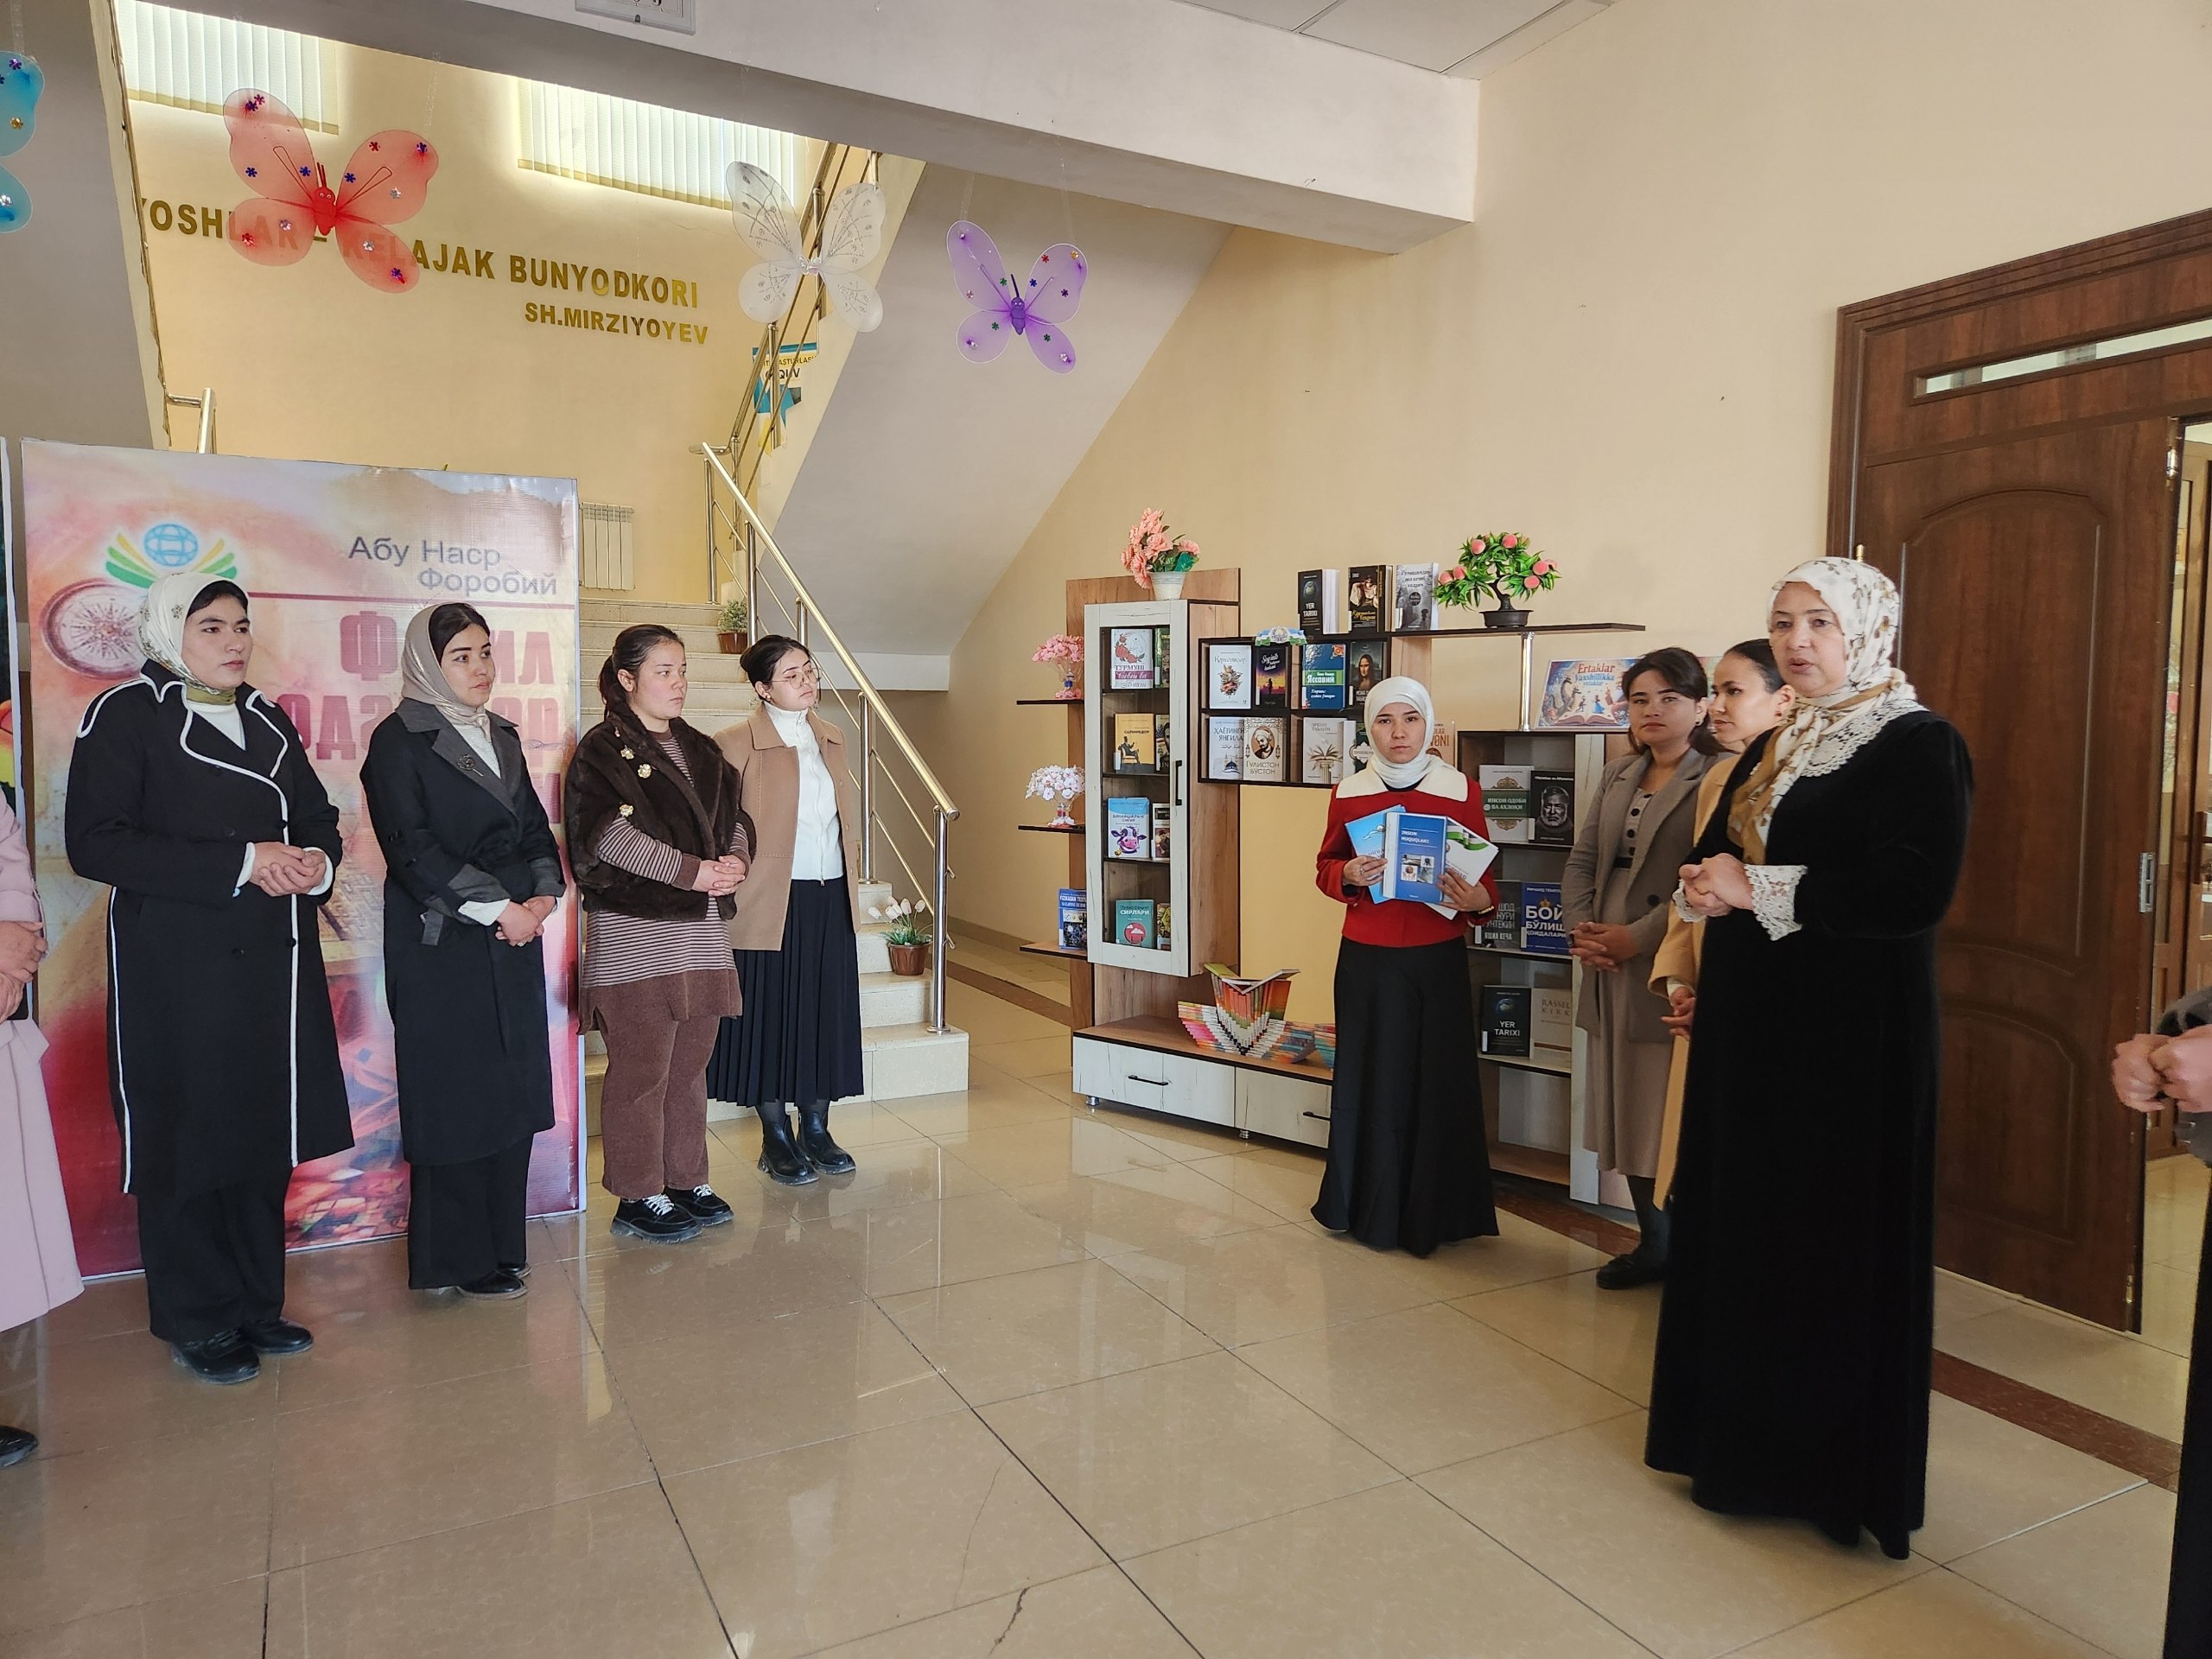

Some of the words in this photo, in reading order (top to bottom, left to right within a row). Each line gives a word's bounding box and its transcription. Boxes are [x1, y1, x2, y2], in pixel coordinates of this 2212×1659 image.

[142, 198, 299, 251] OSHLAR
[510, 255, 698, 308] BUNYODKORI
[524, 302, 709, 344] SH.MIRZIYOYEV
[348, 536, 410, 567] Абу
[422, 540, 500, 570] Наср
[418, 568, 557, 596] Форобий
[1578, 663, 1616, 674] Ertaklar
[1525, 904, 1563, 921] БОЙ
[1541, 999, 1570, 1009] RASSEL
[1541, 1007, 1570, 1016] KIRK
[1494, 1028, 1521, 1037] TARIXI
